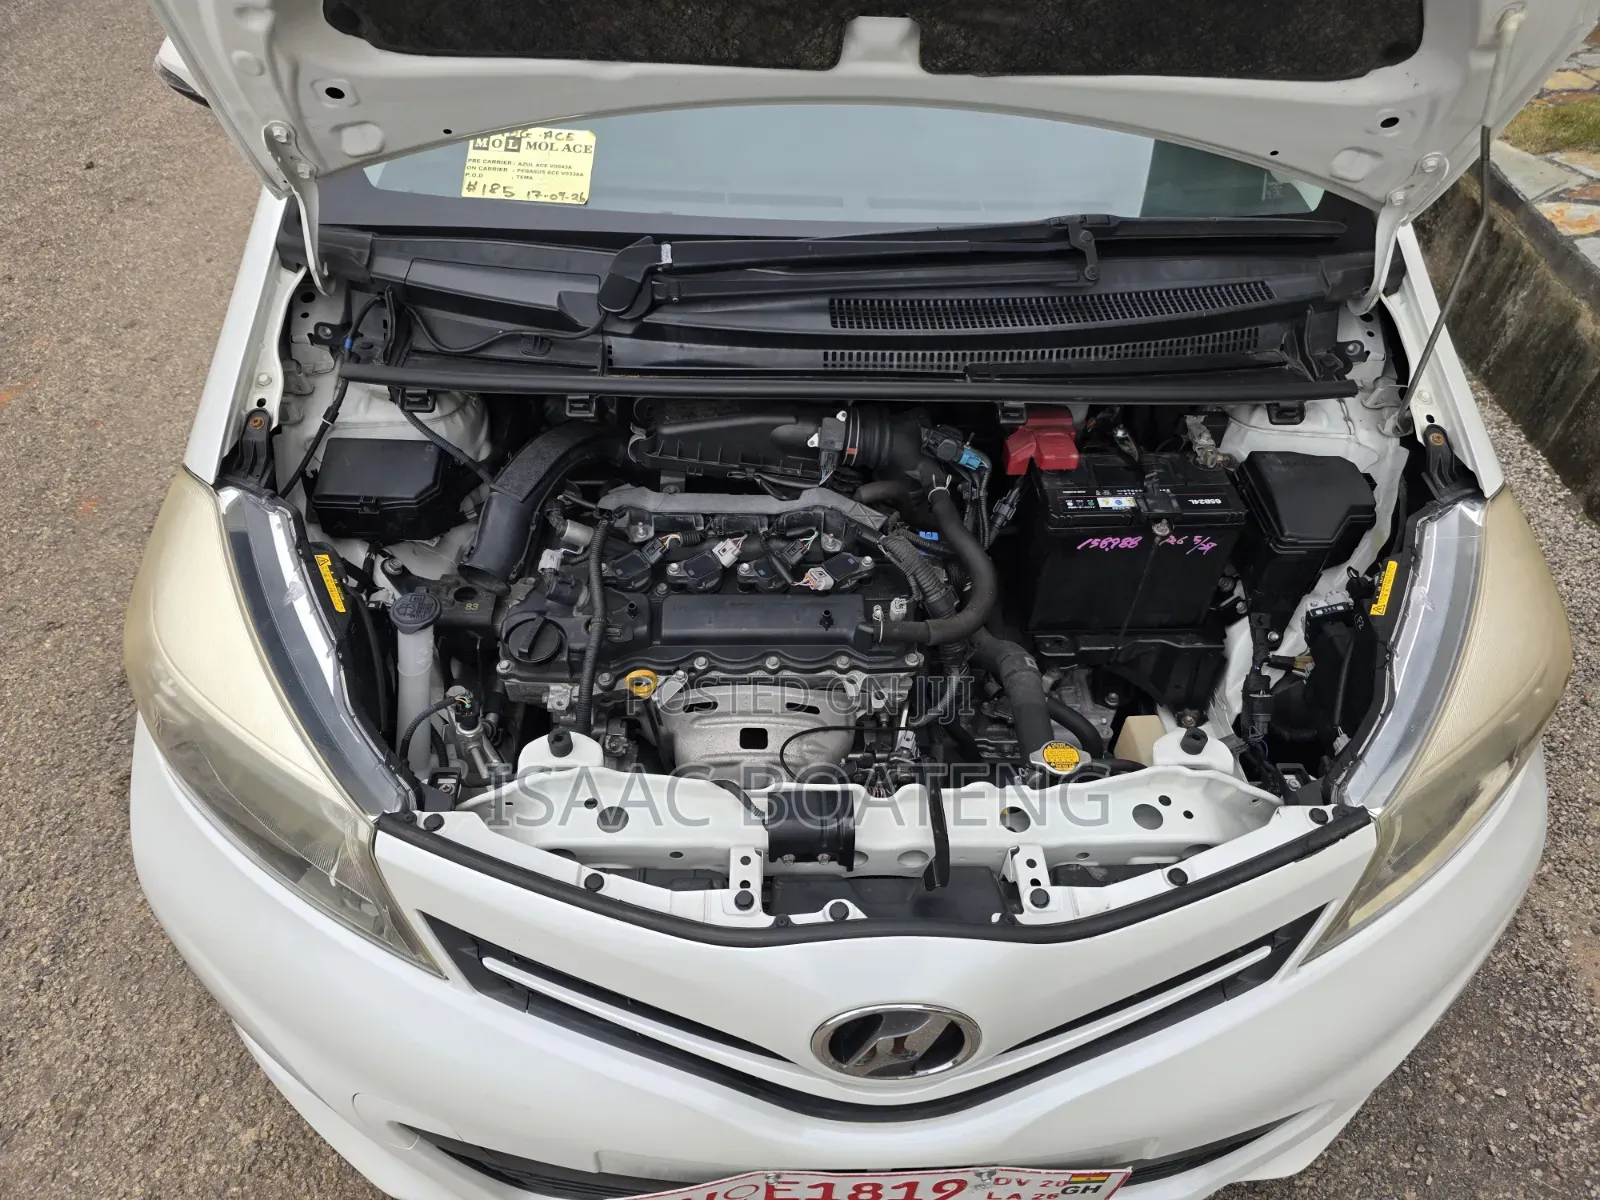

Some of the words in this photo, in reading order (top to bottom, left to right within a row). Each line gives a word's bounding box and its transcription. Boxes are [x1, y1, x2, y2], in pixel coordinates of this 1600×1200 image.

[473, 137, 521, 152] MOL
[525, 141, 559, 152] MOL
[561, 142, 593, 154] ACE
[1060, 1184, 1103, 1195] GH
